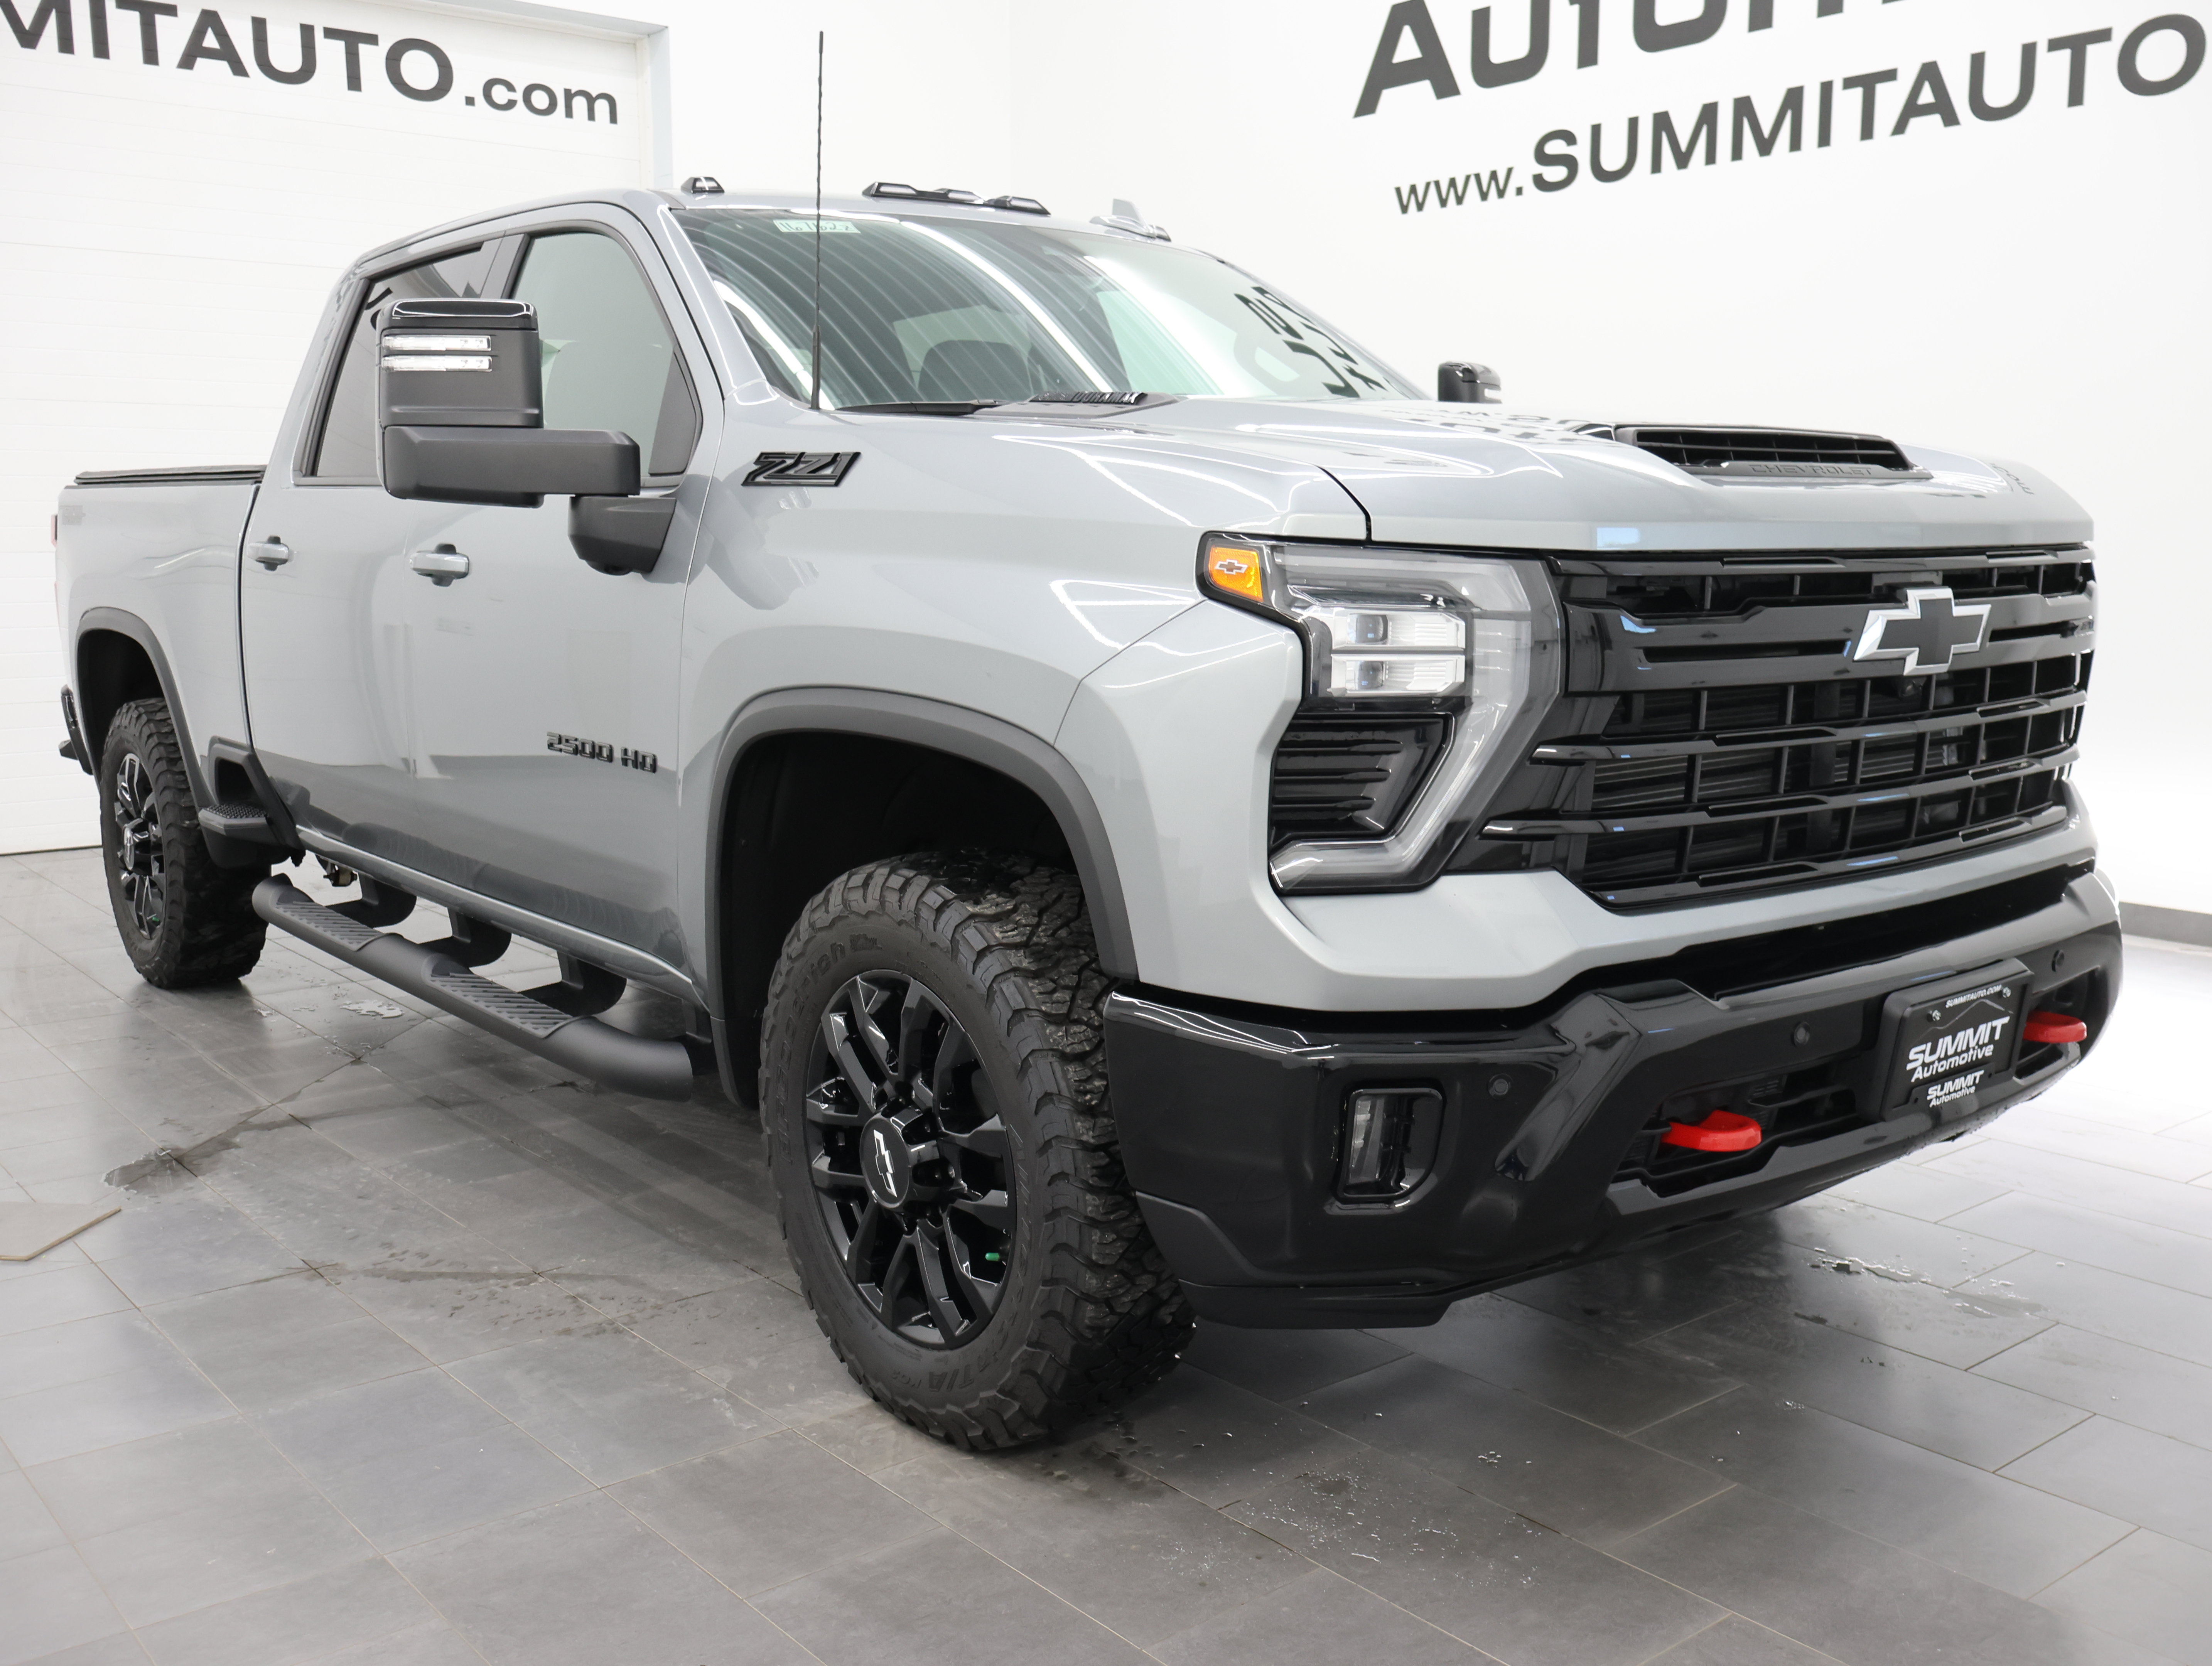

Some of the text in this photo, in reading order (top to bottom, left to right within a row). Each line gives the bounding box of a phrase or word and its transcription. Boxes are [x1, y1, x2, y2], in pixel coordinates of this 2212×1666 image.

[1395, 14, 2206, 214] www.SUMMITAUTO
[741, 452, 861, 487] Z71
[1749, 464, 1871, 476] CHEVROLET
[547, 732, 658, 773] 2500 HD
[1906, 1016, 2010, 1071] SUMMIT
[1911, 1044, 1994, 1083] Automotive
[1927, 1070, 1984, 1100] SUMMIT
[1929, 1086, 1976, 1108] Automotive
[928, 1364, 975, 1393] T/A
